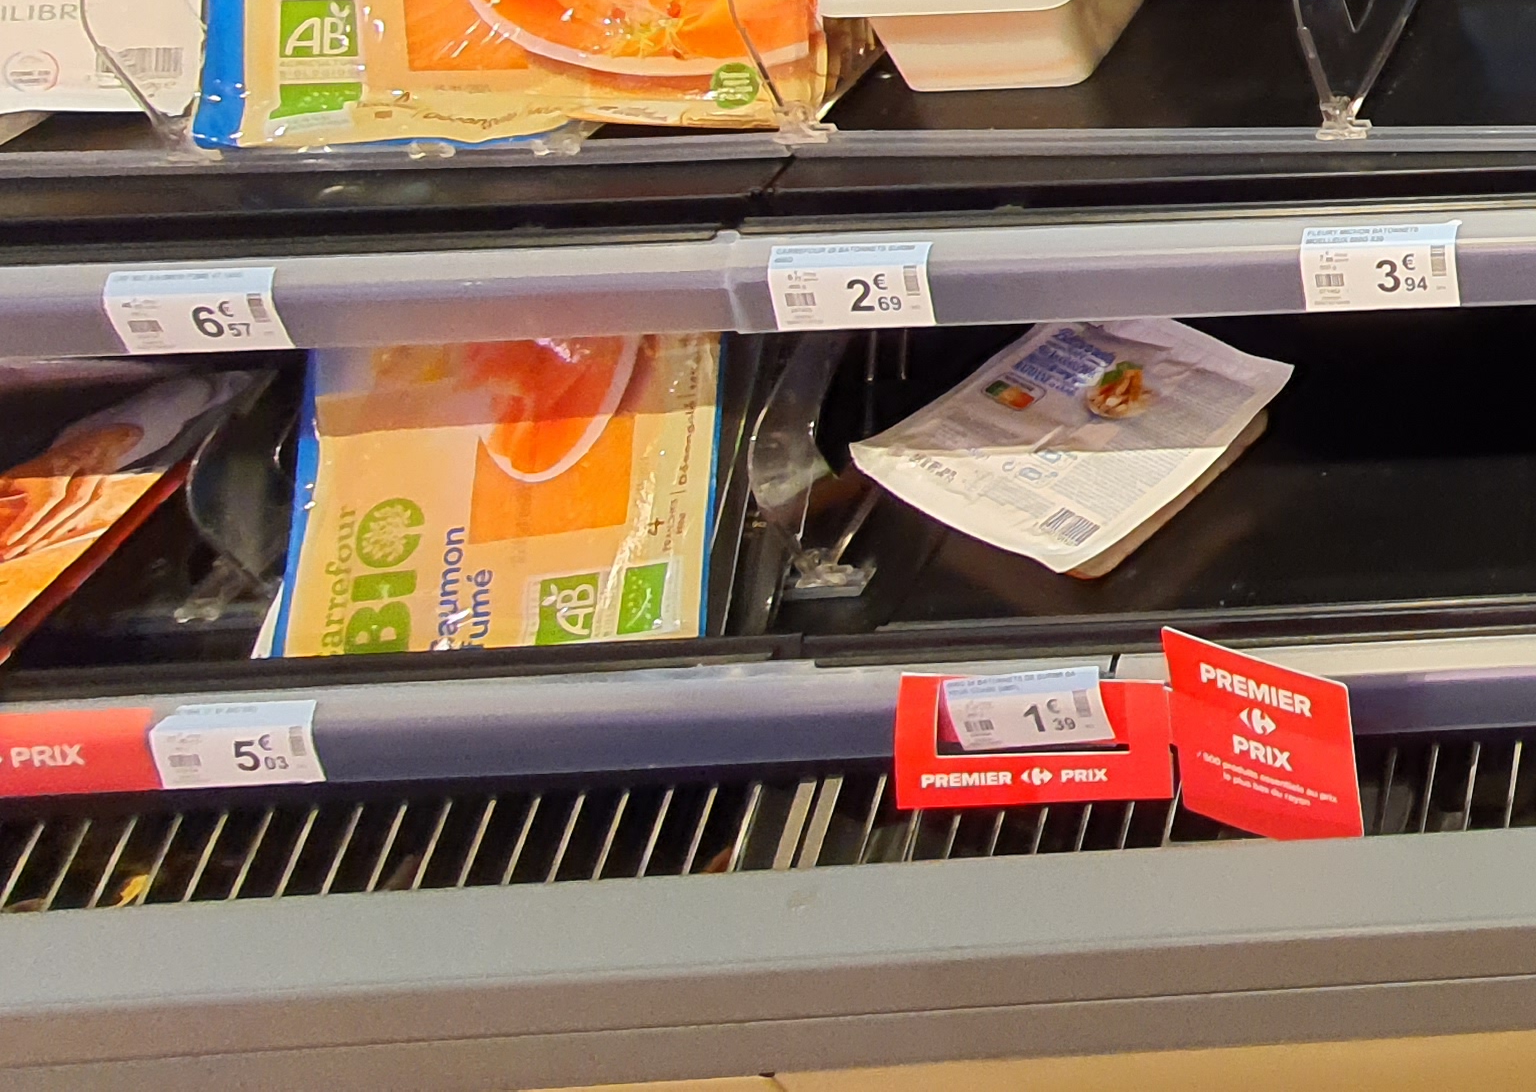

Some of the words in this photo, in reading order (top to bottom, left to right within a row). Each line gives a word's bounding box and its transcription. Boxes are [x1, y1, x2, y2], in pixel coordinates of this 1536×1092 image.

[284, 15, 352, 57] AB
[322, 506, 357, 656] arrefour
[1198, 661, 1313, 719] PREMIER
[10, 742, 86, 769] PRIX
[1231, 733, 1293, 772] PRIX
[920, 770, 1013, 789] PREMIER
[1060, 768, 1109, 784] PRIX
